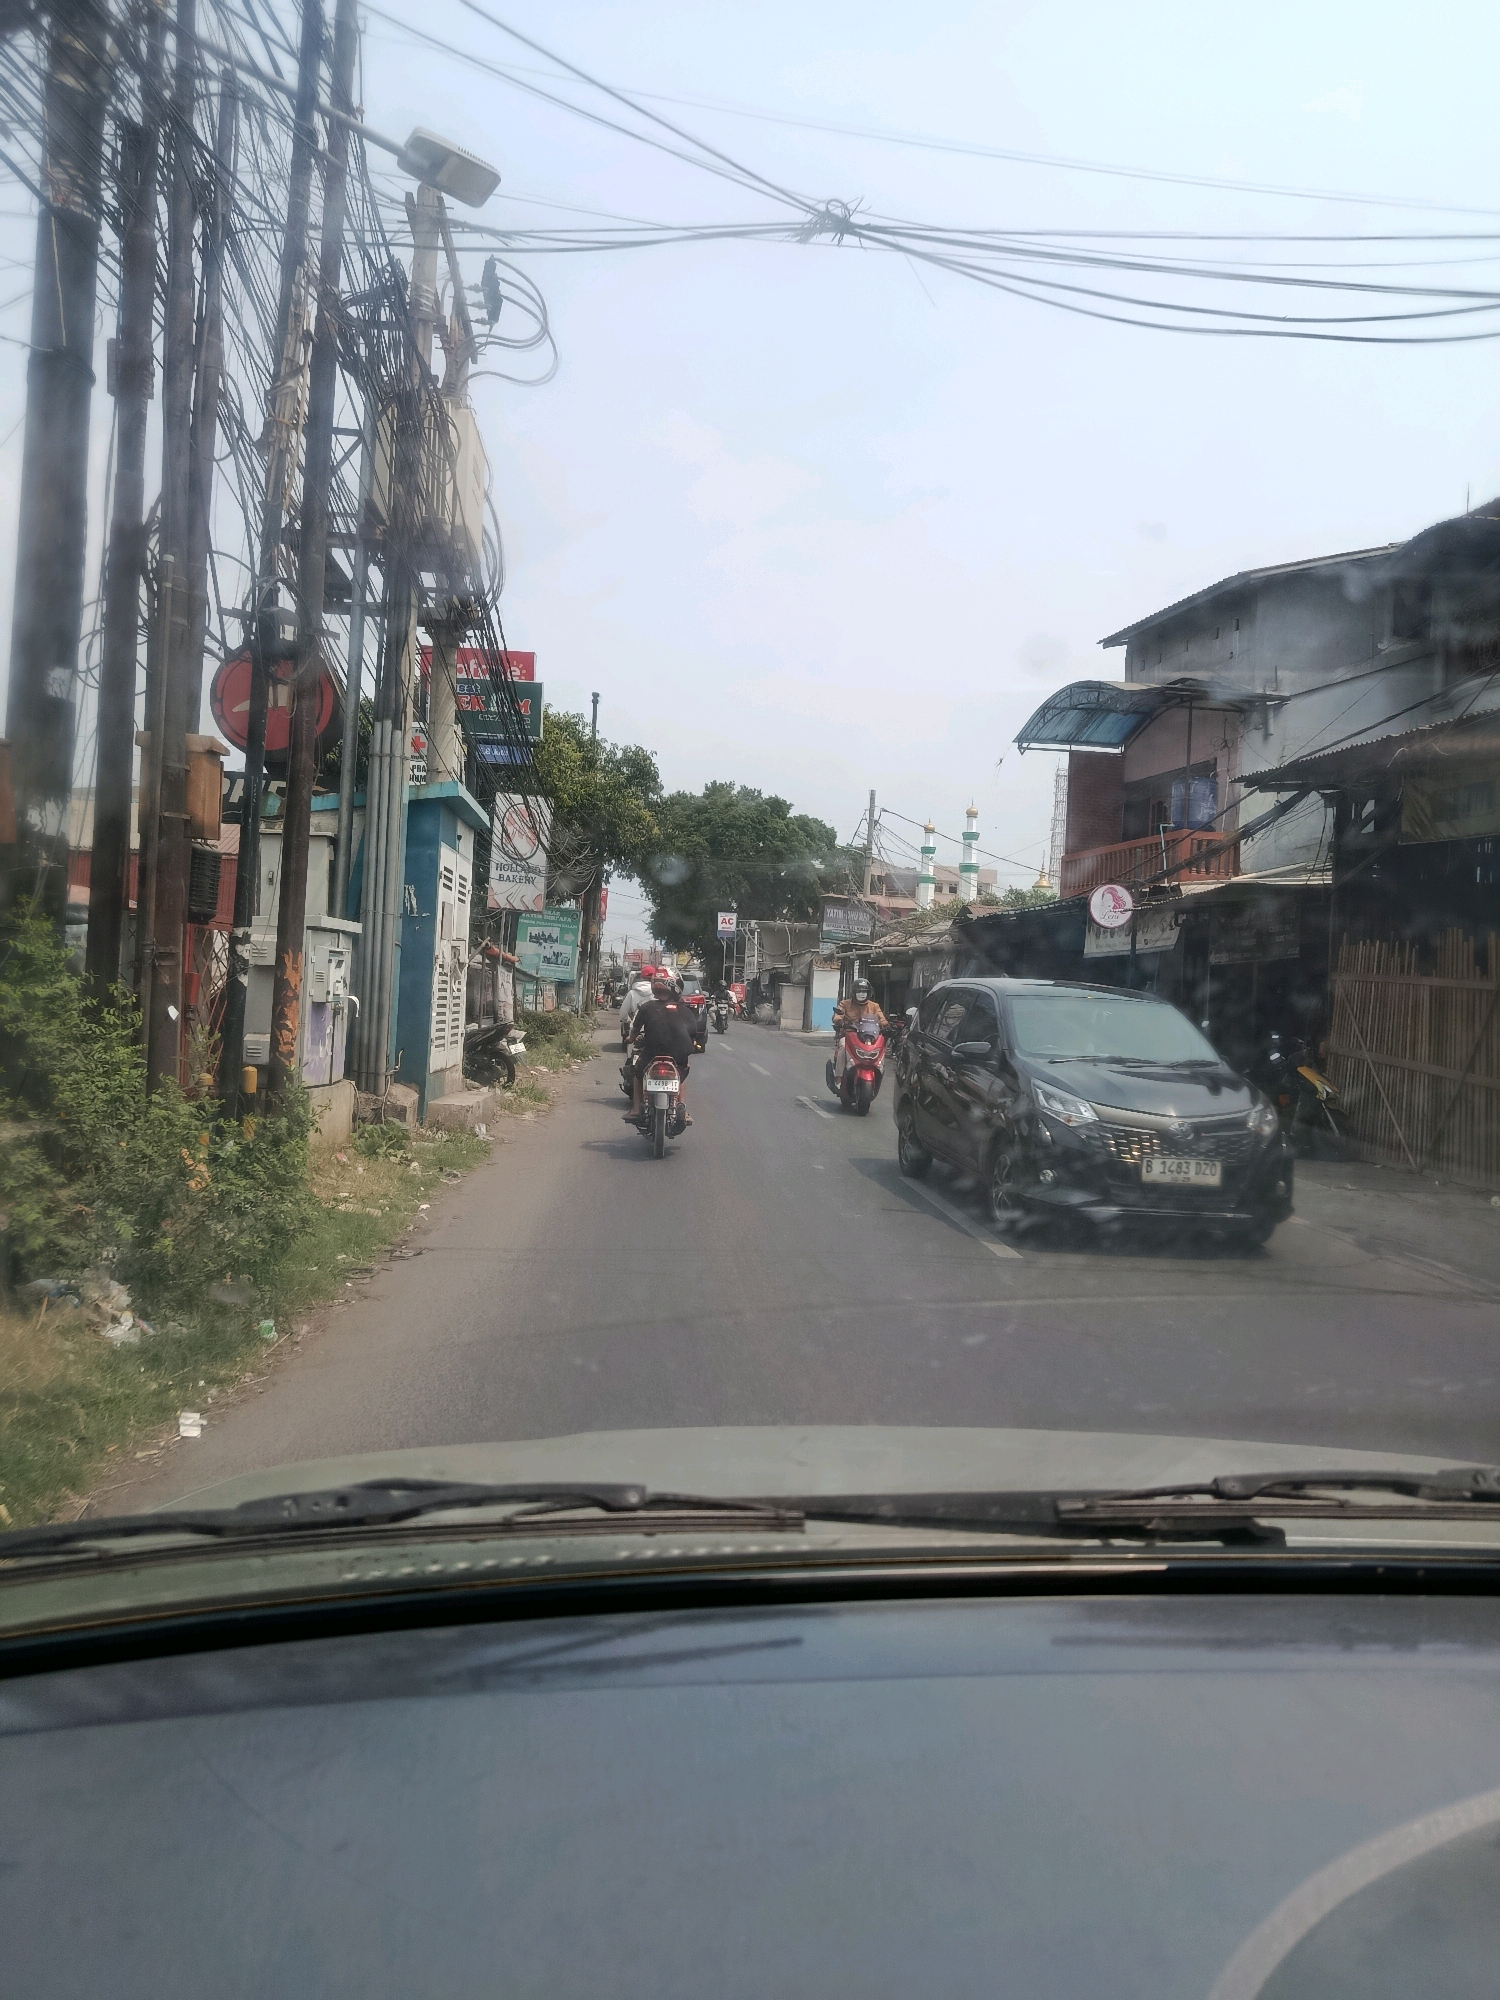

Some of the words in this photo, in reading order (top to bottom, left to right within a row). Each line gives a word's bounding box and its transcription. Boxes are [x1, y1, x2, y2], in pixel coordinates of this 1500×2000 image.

[498, 873, 537, 885] BAKERY
[1100, 911, 1120, 920] Leni
[720, 917, 734, 925] AC
[1145, 1159, 1153, 1174] B
[1159, 1160, 1191, 1175] 1483
[1194, 1162, 1218, 1177] DZO
